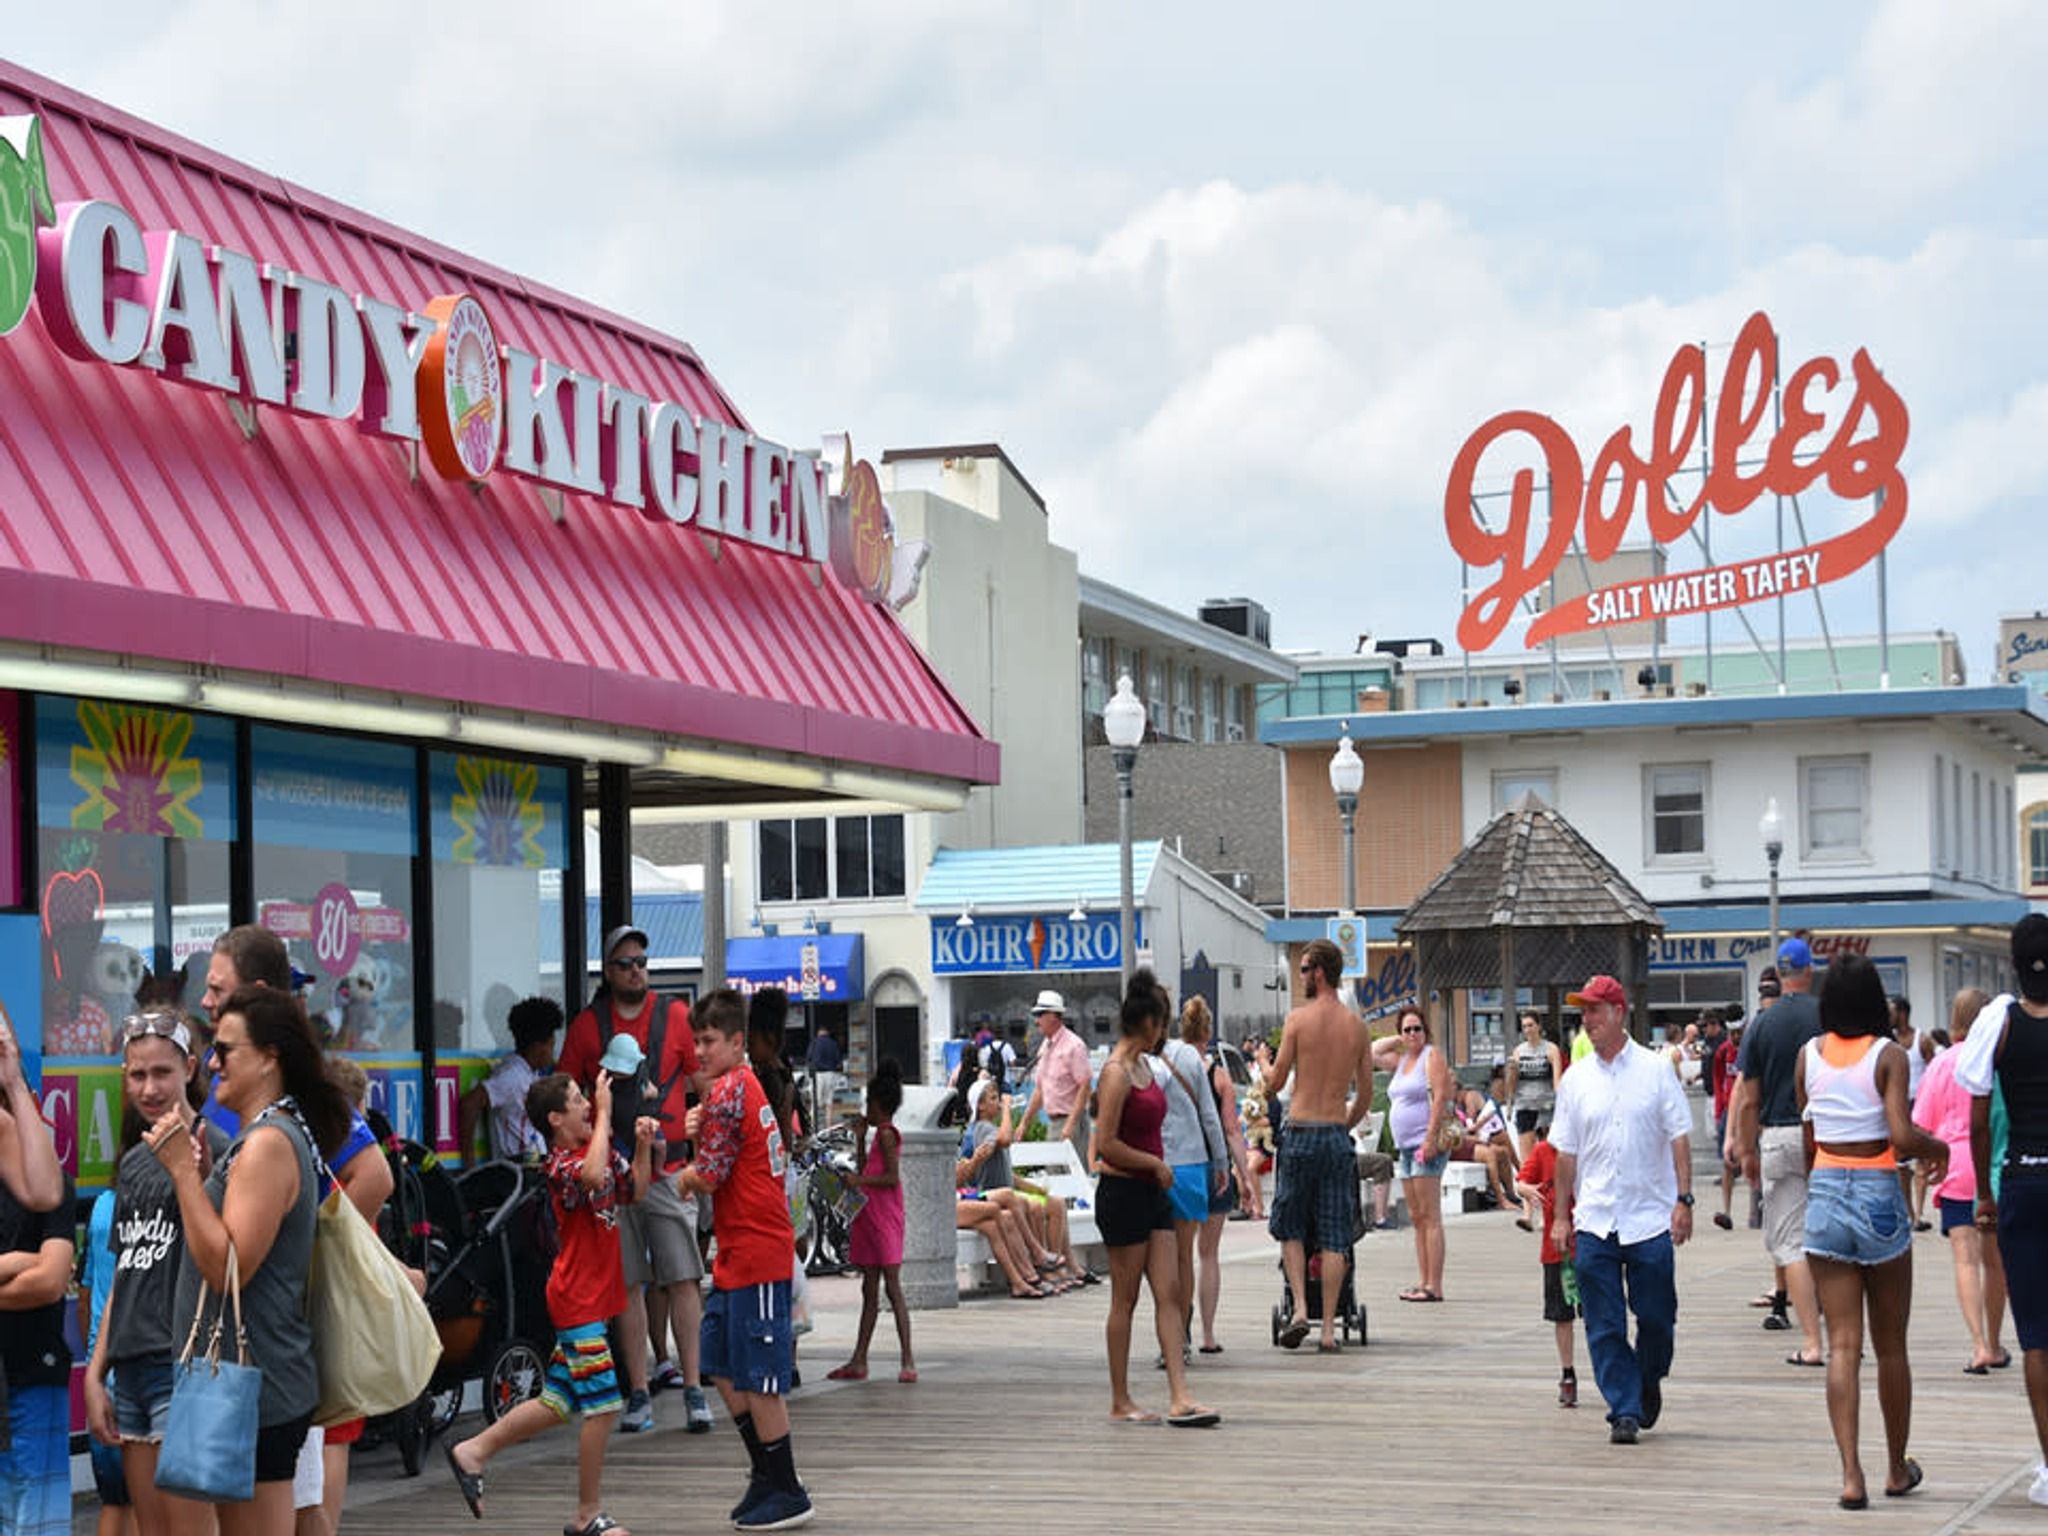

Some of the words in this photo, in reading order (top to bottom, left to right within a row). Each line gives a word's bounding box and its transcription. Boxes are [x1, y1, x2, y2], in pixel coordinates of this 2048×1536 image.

[60, 200, 437, 441] CANDY
[503, 344, 832, 563] KITCHEN
[1444, 310, 1910, 651] Dolles
[1587, 586, 1642, 626] SALT
[1650, 571, 1736, 616] WATER
[1741, 551, 1821, 599] TAFFY
[318, 898, 348, 961] 80
[935, 924, 1025, 964] KOHR
